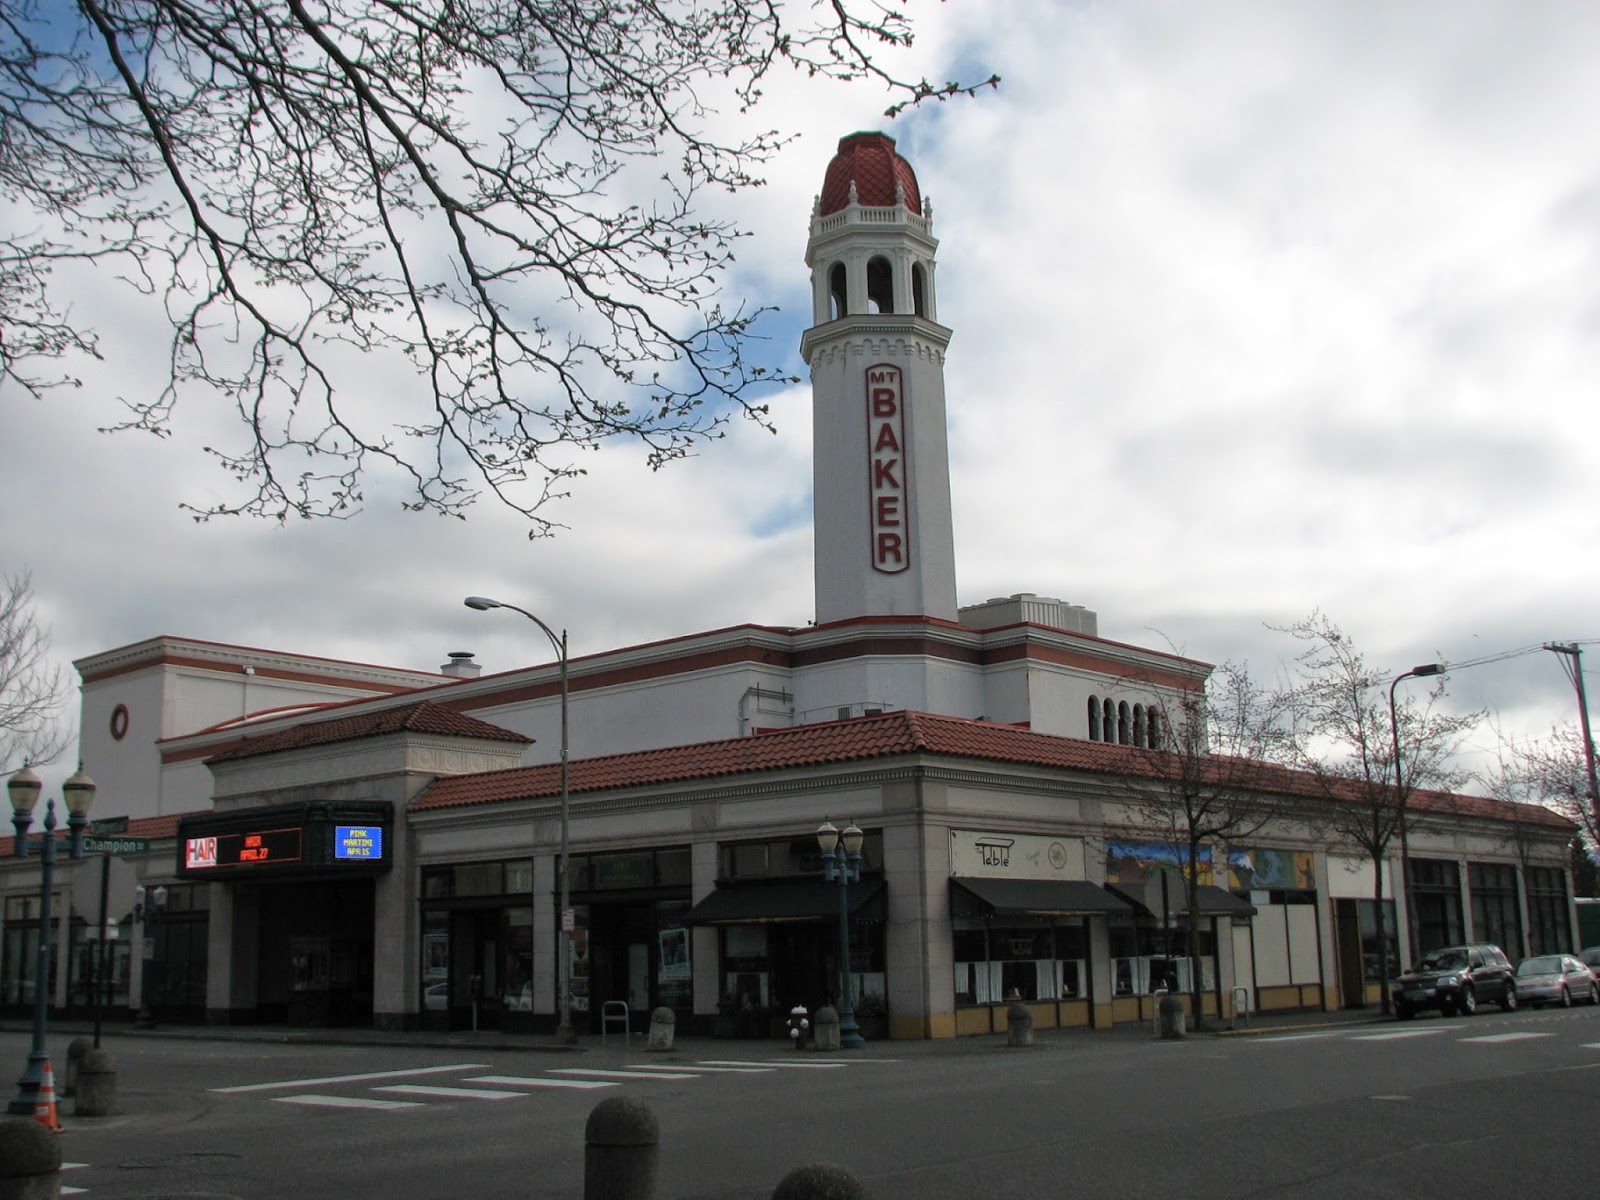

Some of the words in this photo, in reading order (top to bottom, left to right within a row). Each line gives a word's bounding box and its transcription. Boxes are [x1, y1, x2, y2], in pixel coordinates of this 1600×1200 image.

[870, 371, 897, 383] MT
[873, 387, 902, 564] BAKER
[350, 829, 367, 838] PINK
[83, 838, 136, 853] Champion
[342, 838, 374, 847] MARTINI
[187, 837, 217, 861] HAIR
[259, 847, 269, 859] 27
[347, 848, 361, 856] APR
[362, 848, 371, 856] 15
[975, 841, 1010, 867] Table
